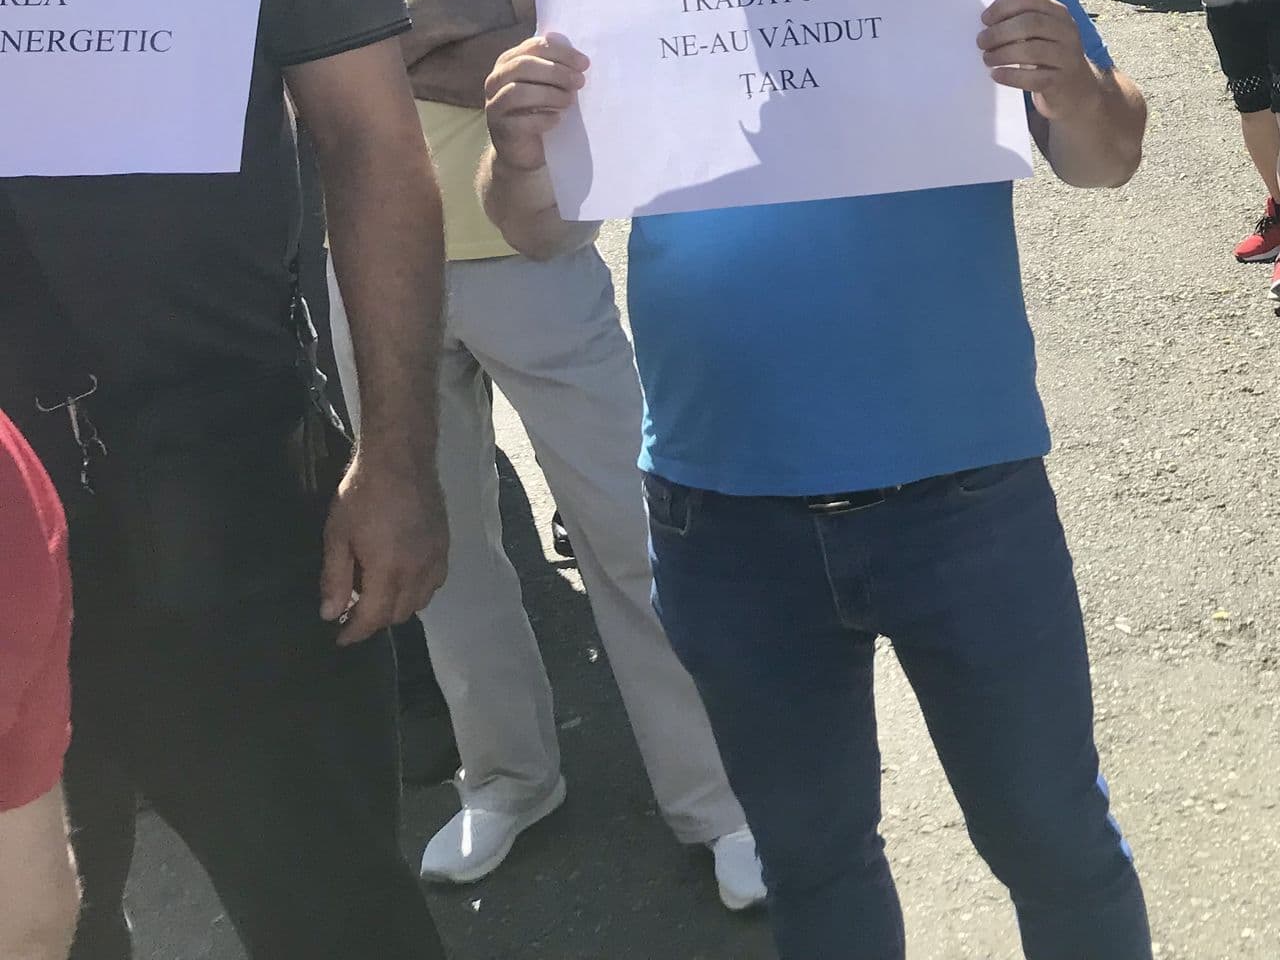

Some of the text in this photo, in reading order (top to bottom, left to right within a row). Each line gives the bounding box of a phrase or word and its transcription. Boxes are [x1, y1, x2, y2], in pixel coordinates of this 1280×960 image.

[0, 30, 172, 54] NERGETIC
[659, 17, 882, 58] NE-AU VÂNDUT
